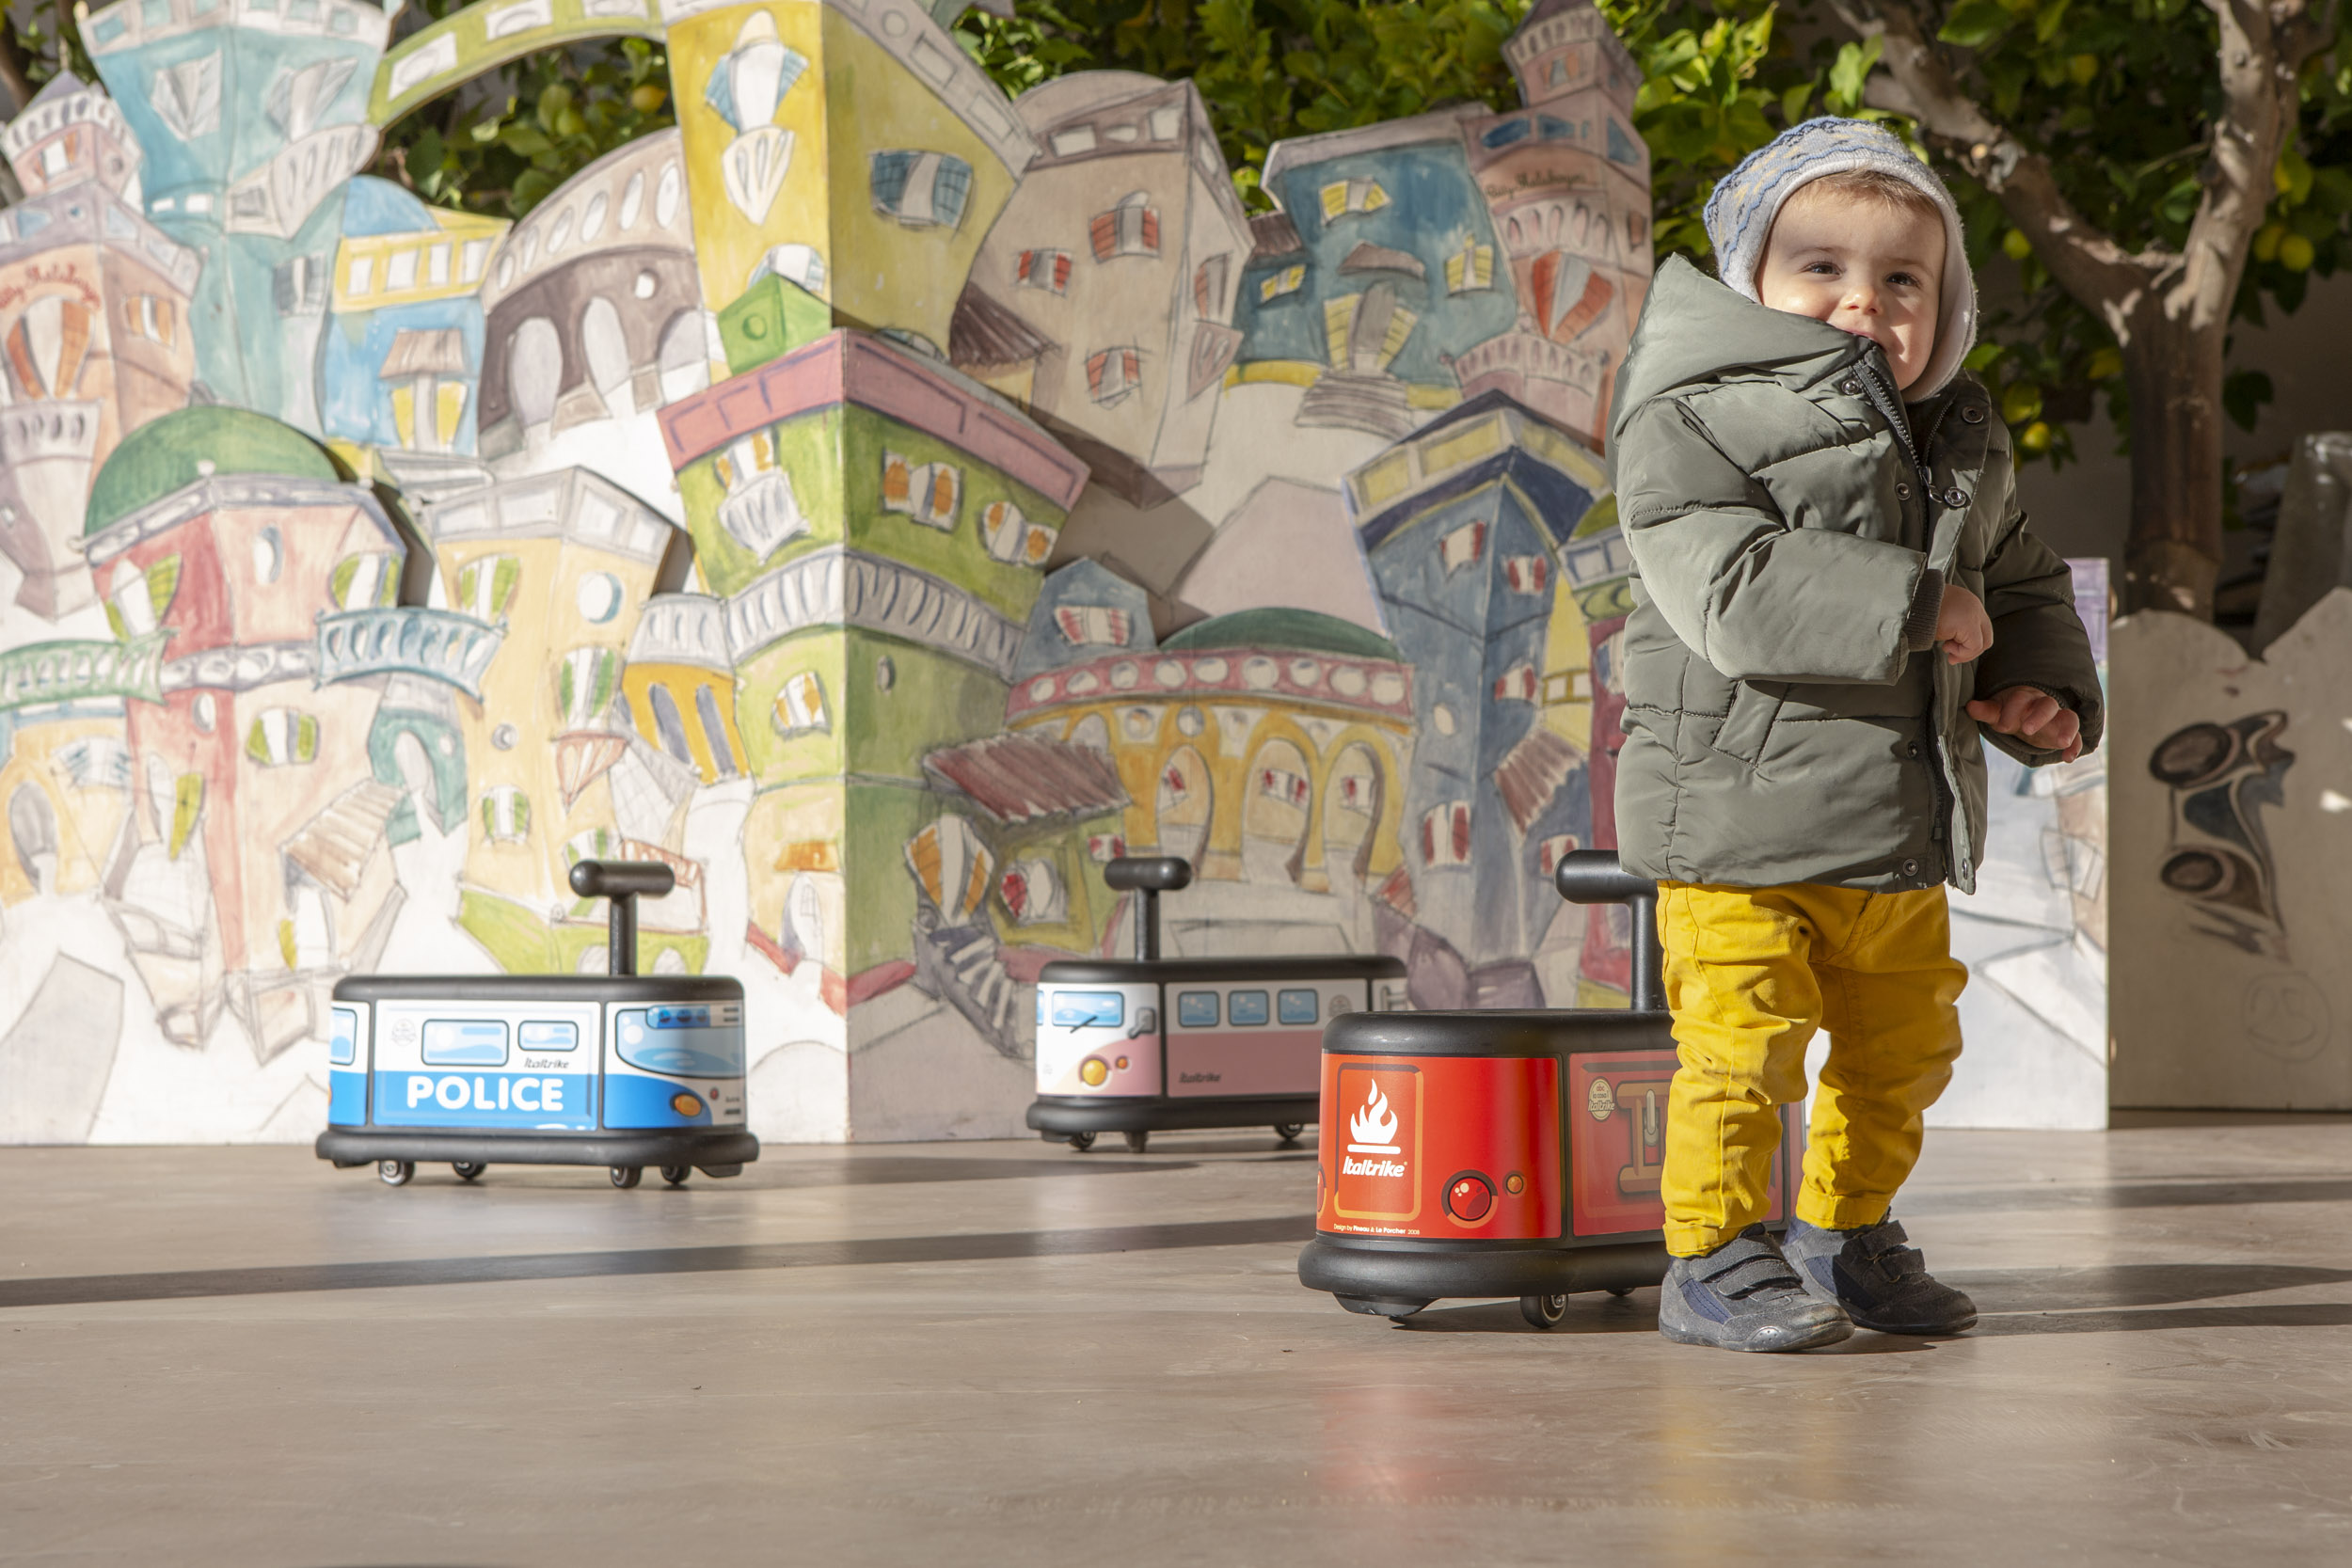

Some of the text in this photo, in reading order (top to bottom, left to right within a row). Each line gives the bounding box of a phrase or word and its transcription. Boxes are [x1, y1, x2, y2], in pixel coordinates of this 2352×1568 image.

[523, 1056, 569, 1069] Italtrike
[407, 1075, 564, 1112] POLICE
[1343, 1156, 1405, 1178] Italtrike
